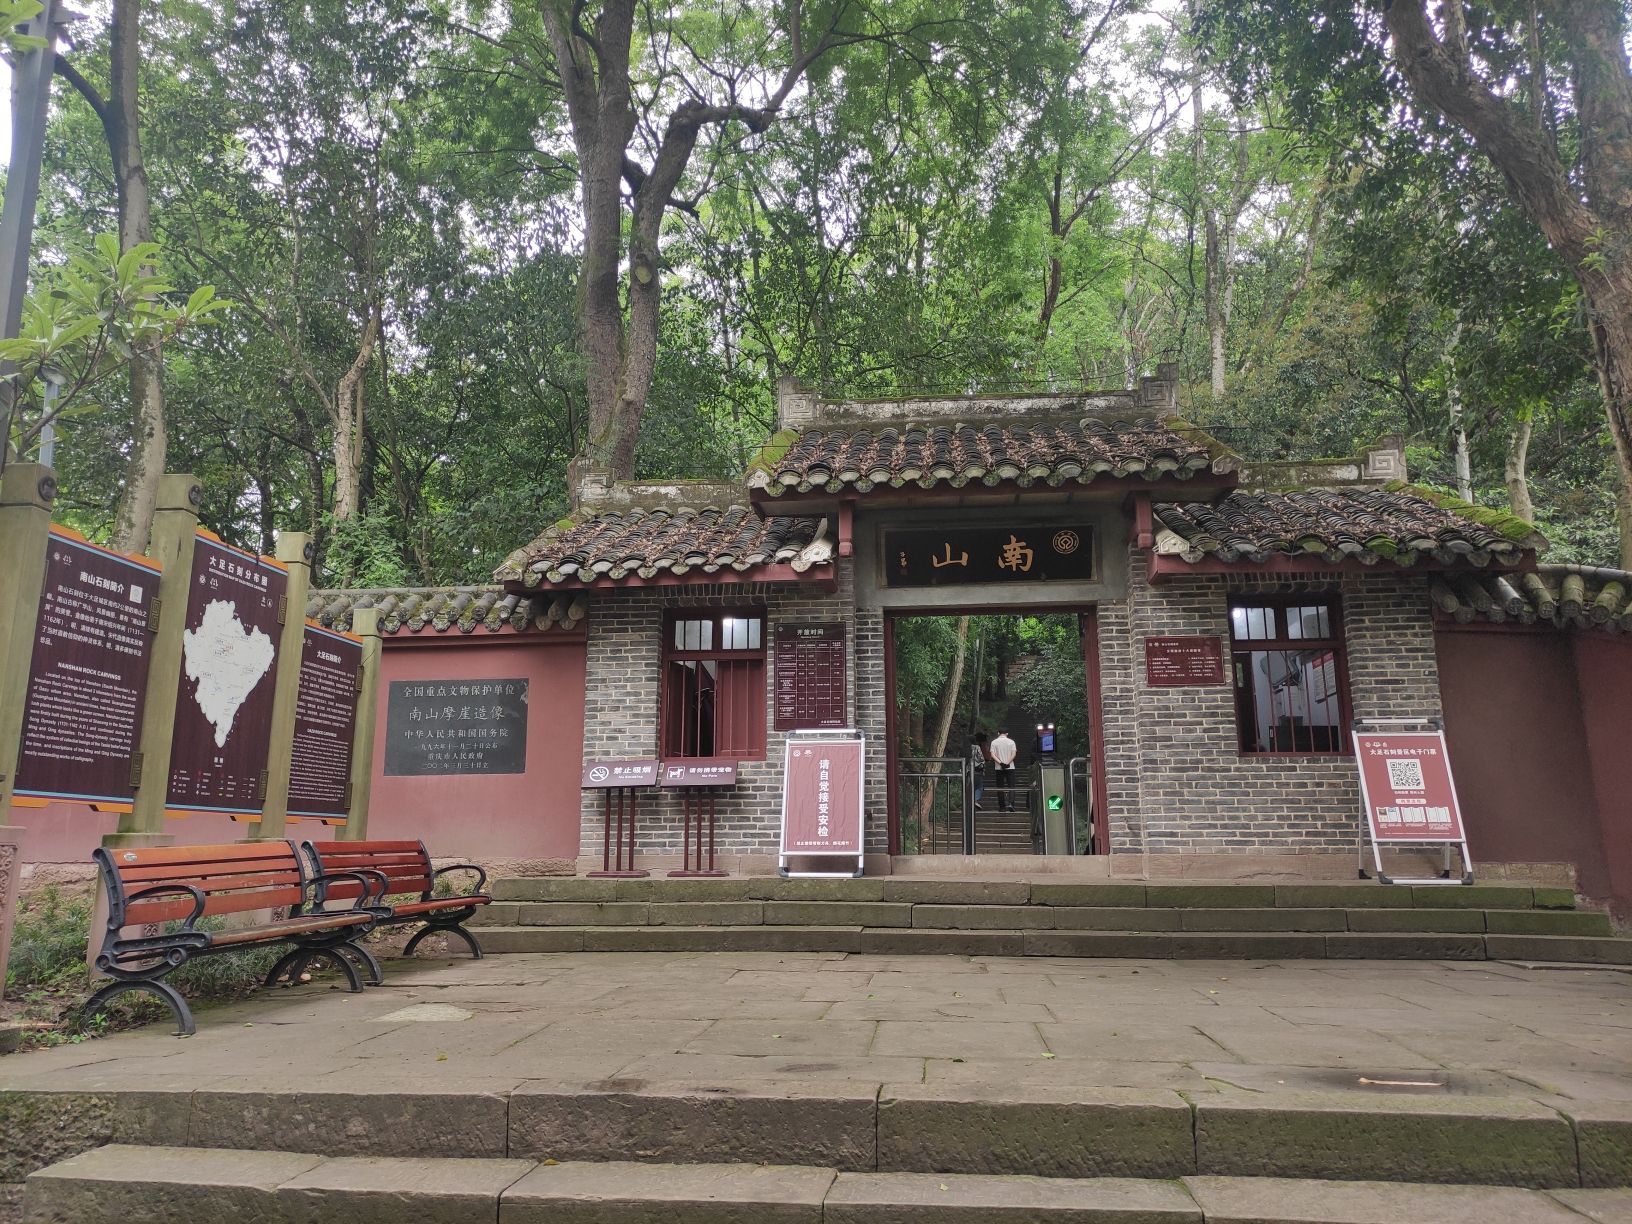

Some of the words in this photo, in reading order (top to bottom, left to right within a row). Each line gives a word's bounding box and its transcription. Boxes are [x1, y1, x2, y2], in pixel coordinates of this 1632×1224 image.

[209, 556, 267, 586] 大足石刻分布图
[80, 571, 124, 594] 南山石刻简介
[58, 662, 82, 672] NANSHAN
[97, 670, 121, 680] CARVINGS
[404, 685, 515, 697] 全国重点文物保护单位
[409, 706, 505, 721] 南山摩崖造像
[404, 728, 508, 739] 中华人民共和国国务院
[428, 752, 483, 760] 重庆市人民政府
[614, 766, 651, 774] 禁止吸烟
[818, 760, 829, 836] 请自觉接受安检
